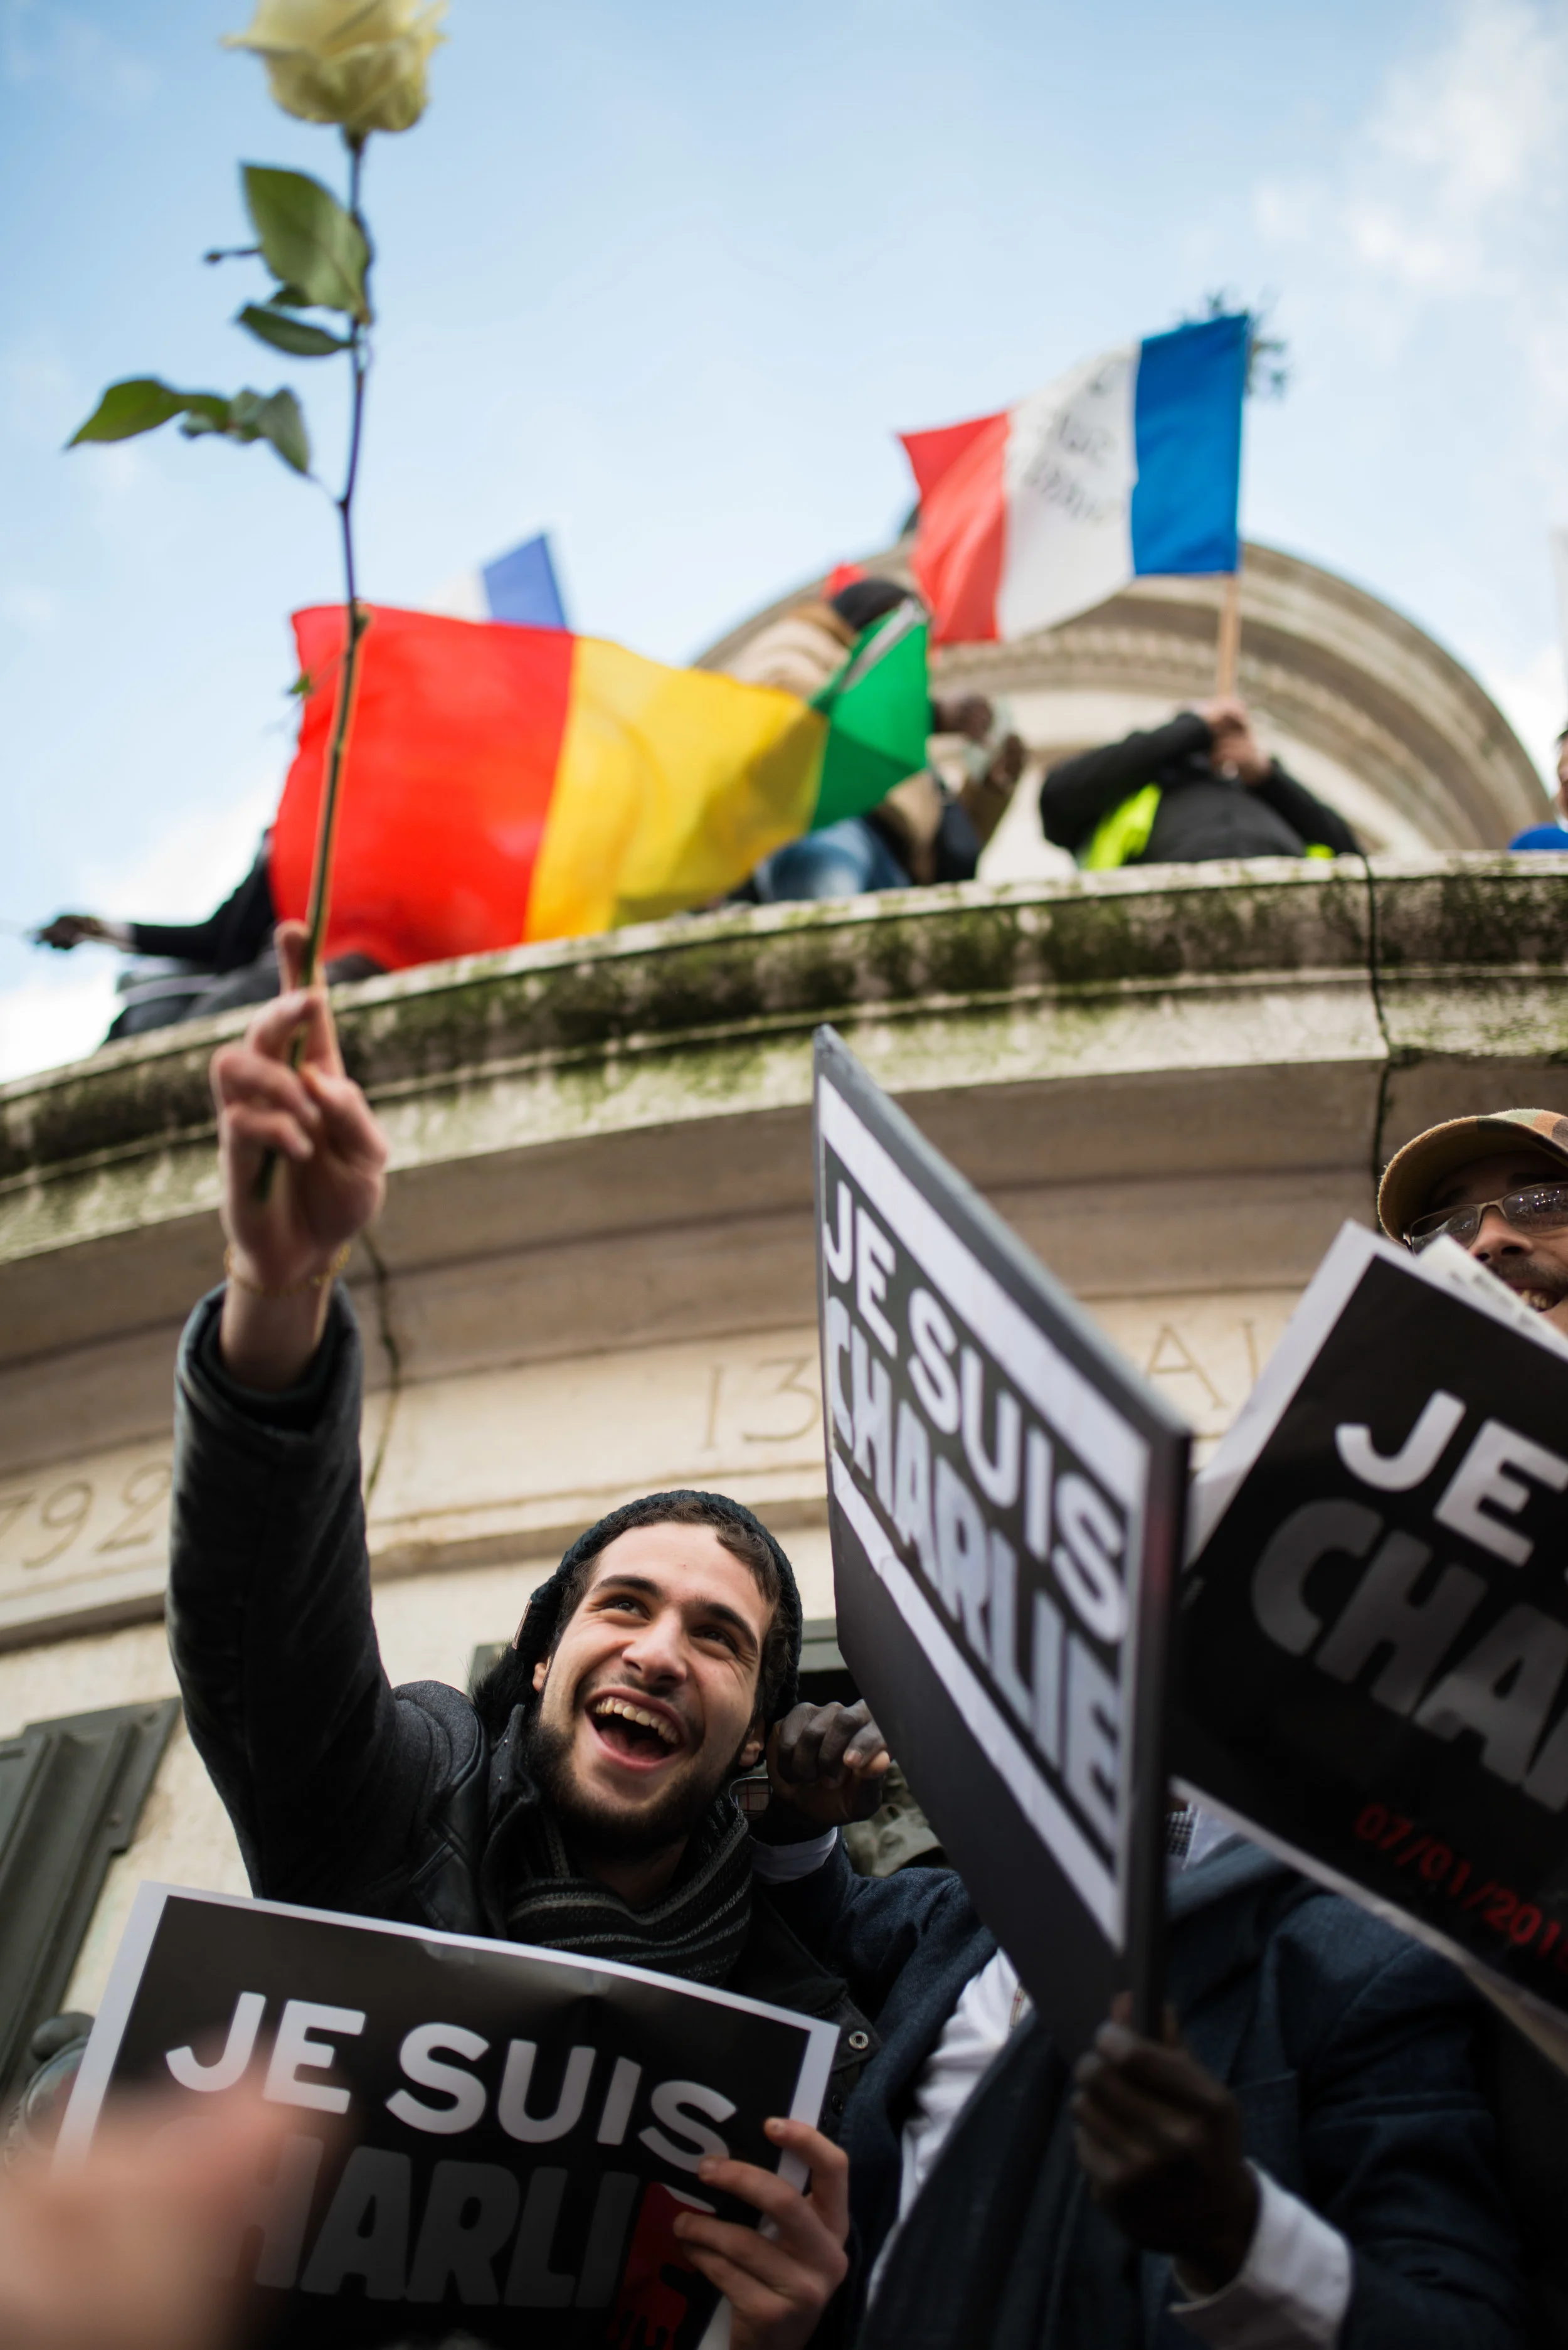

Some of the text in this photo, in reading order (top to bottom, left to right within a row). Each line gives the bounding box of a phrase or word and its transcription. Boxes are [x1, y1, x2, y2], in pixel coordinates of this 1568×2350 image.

[823, 1179, 1127, 1645] JE SUIS
[1334, 1388, 1568, 1568] JE
[826, 1295, 1123, 1860] CHARLIE
[166, 1991, 737, 2176] JE SUIS
